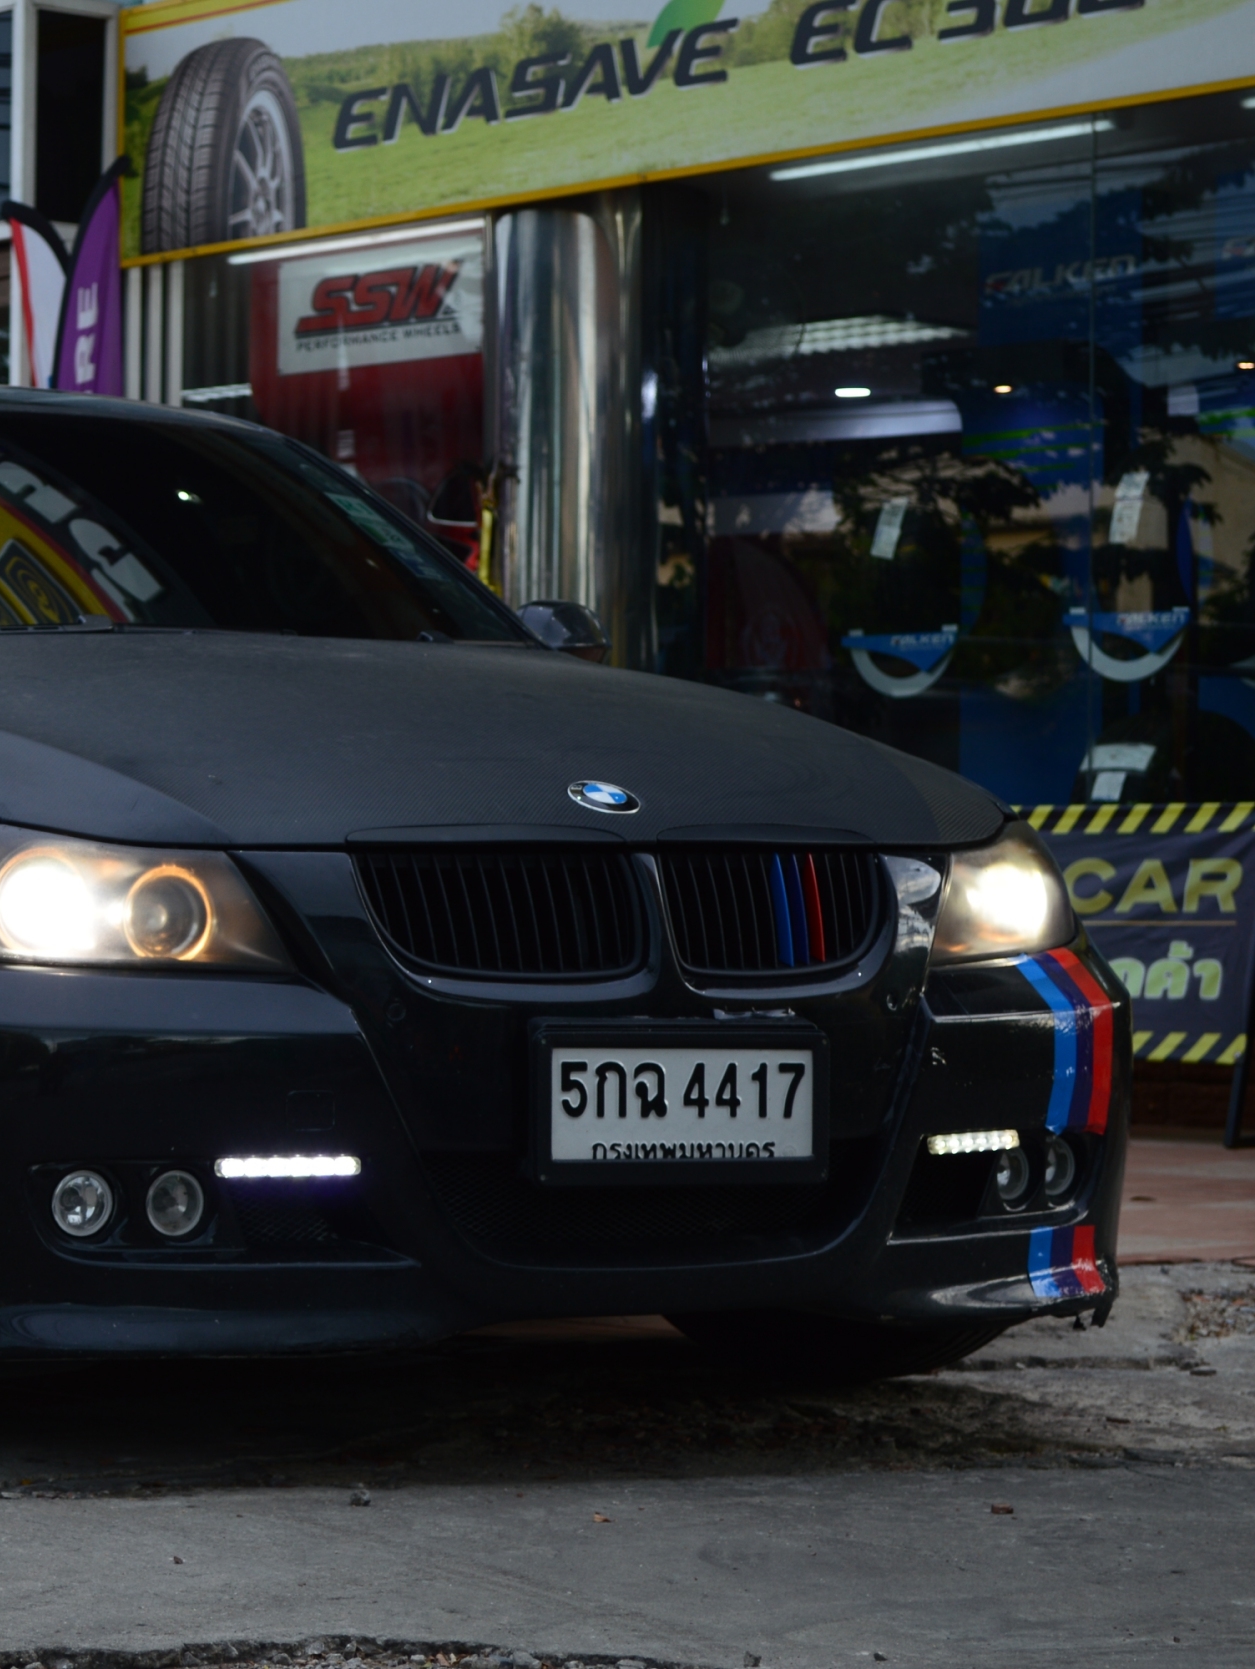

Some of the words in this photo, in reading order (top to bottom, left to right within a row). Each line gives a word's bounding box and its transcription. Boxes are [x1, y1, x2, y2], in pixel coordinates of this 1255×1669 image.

[332, 18, 740, 150] ENASAVE
[789, 0, 1144, 66] EC3
[293, 259, 463, 336] SSW
[73, 281, 98, 393] RE
[1062, 857, 1242, 915] CAR
[560, 1061, 668, 1118] 5กฉ
[682, 1062, 805, 1118] 4417
[592, 1142, 775, 1160] กรงเทพมหานคร
